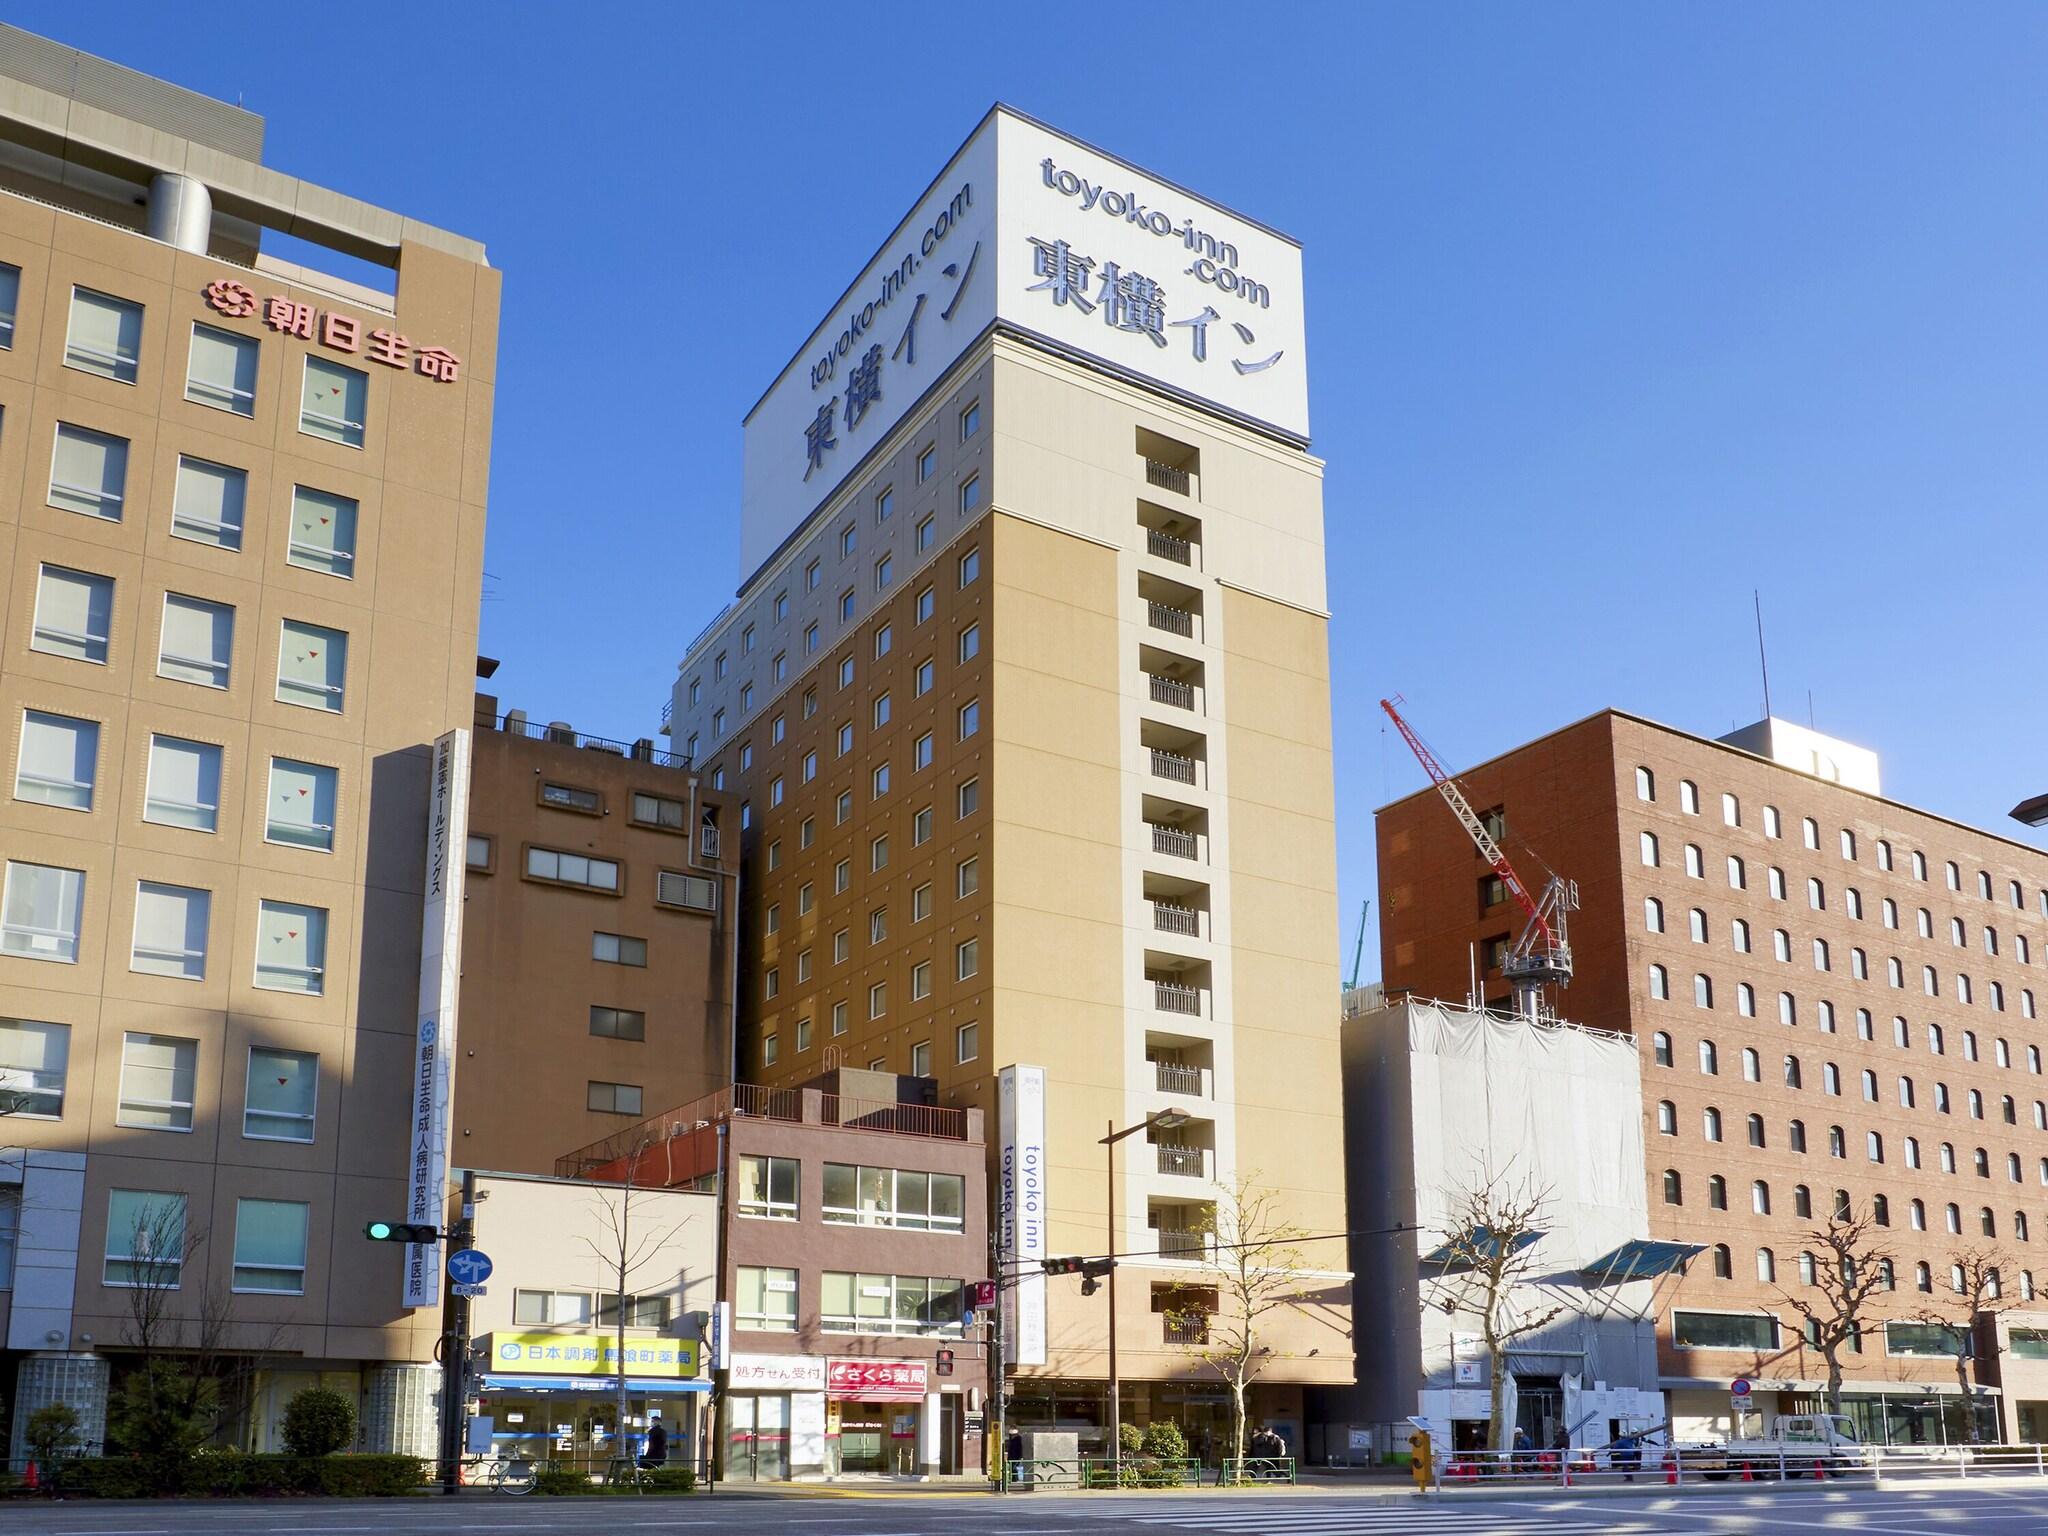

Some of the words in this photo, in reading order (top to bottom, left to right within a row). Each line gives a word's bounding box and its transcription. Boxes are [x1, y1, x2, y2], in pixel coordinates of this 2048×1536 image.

[1040, 158, 1239, 269] toyoko-inn
[810, 183, 972, 391] toyoko-inn.com
[1024, 236, 1284, 376] 東横イン
[1184, 258, 1270, 309] .com
[267, 295, 460, 382] 朝日生命
[803, 240, 980, 483] 東横イン
[410, 1044, 433, 1297] 朝日生命成人病研究所属医院
[1003, 1144, 1014, 1212] toyoko
[1022, 1144, 1041, 1212] toyoko
[1005, 1219, 1014, 1249] inn
[1026, 1219, 1042, 1248] inn
[456, 1286, 483, 1295] 8-20
[529, 1345, 598, 1362] 日本調剤
[604, 1348, 691, 1365] 馬喰町薬局
[736, 1365, 820, 1380] 処方せん受付
[847, 1367, 925, 1384] さくら薬局
